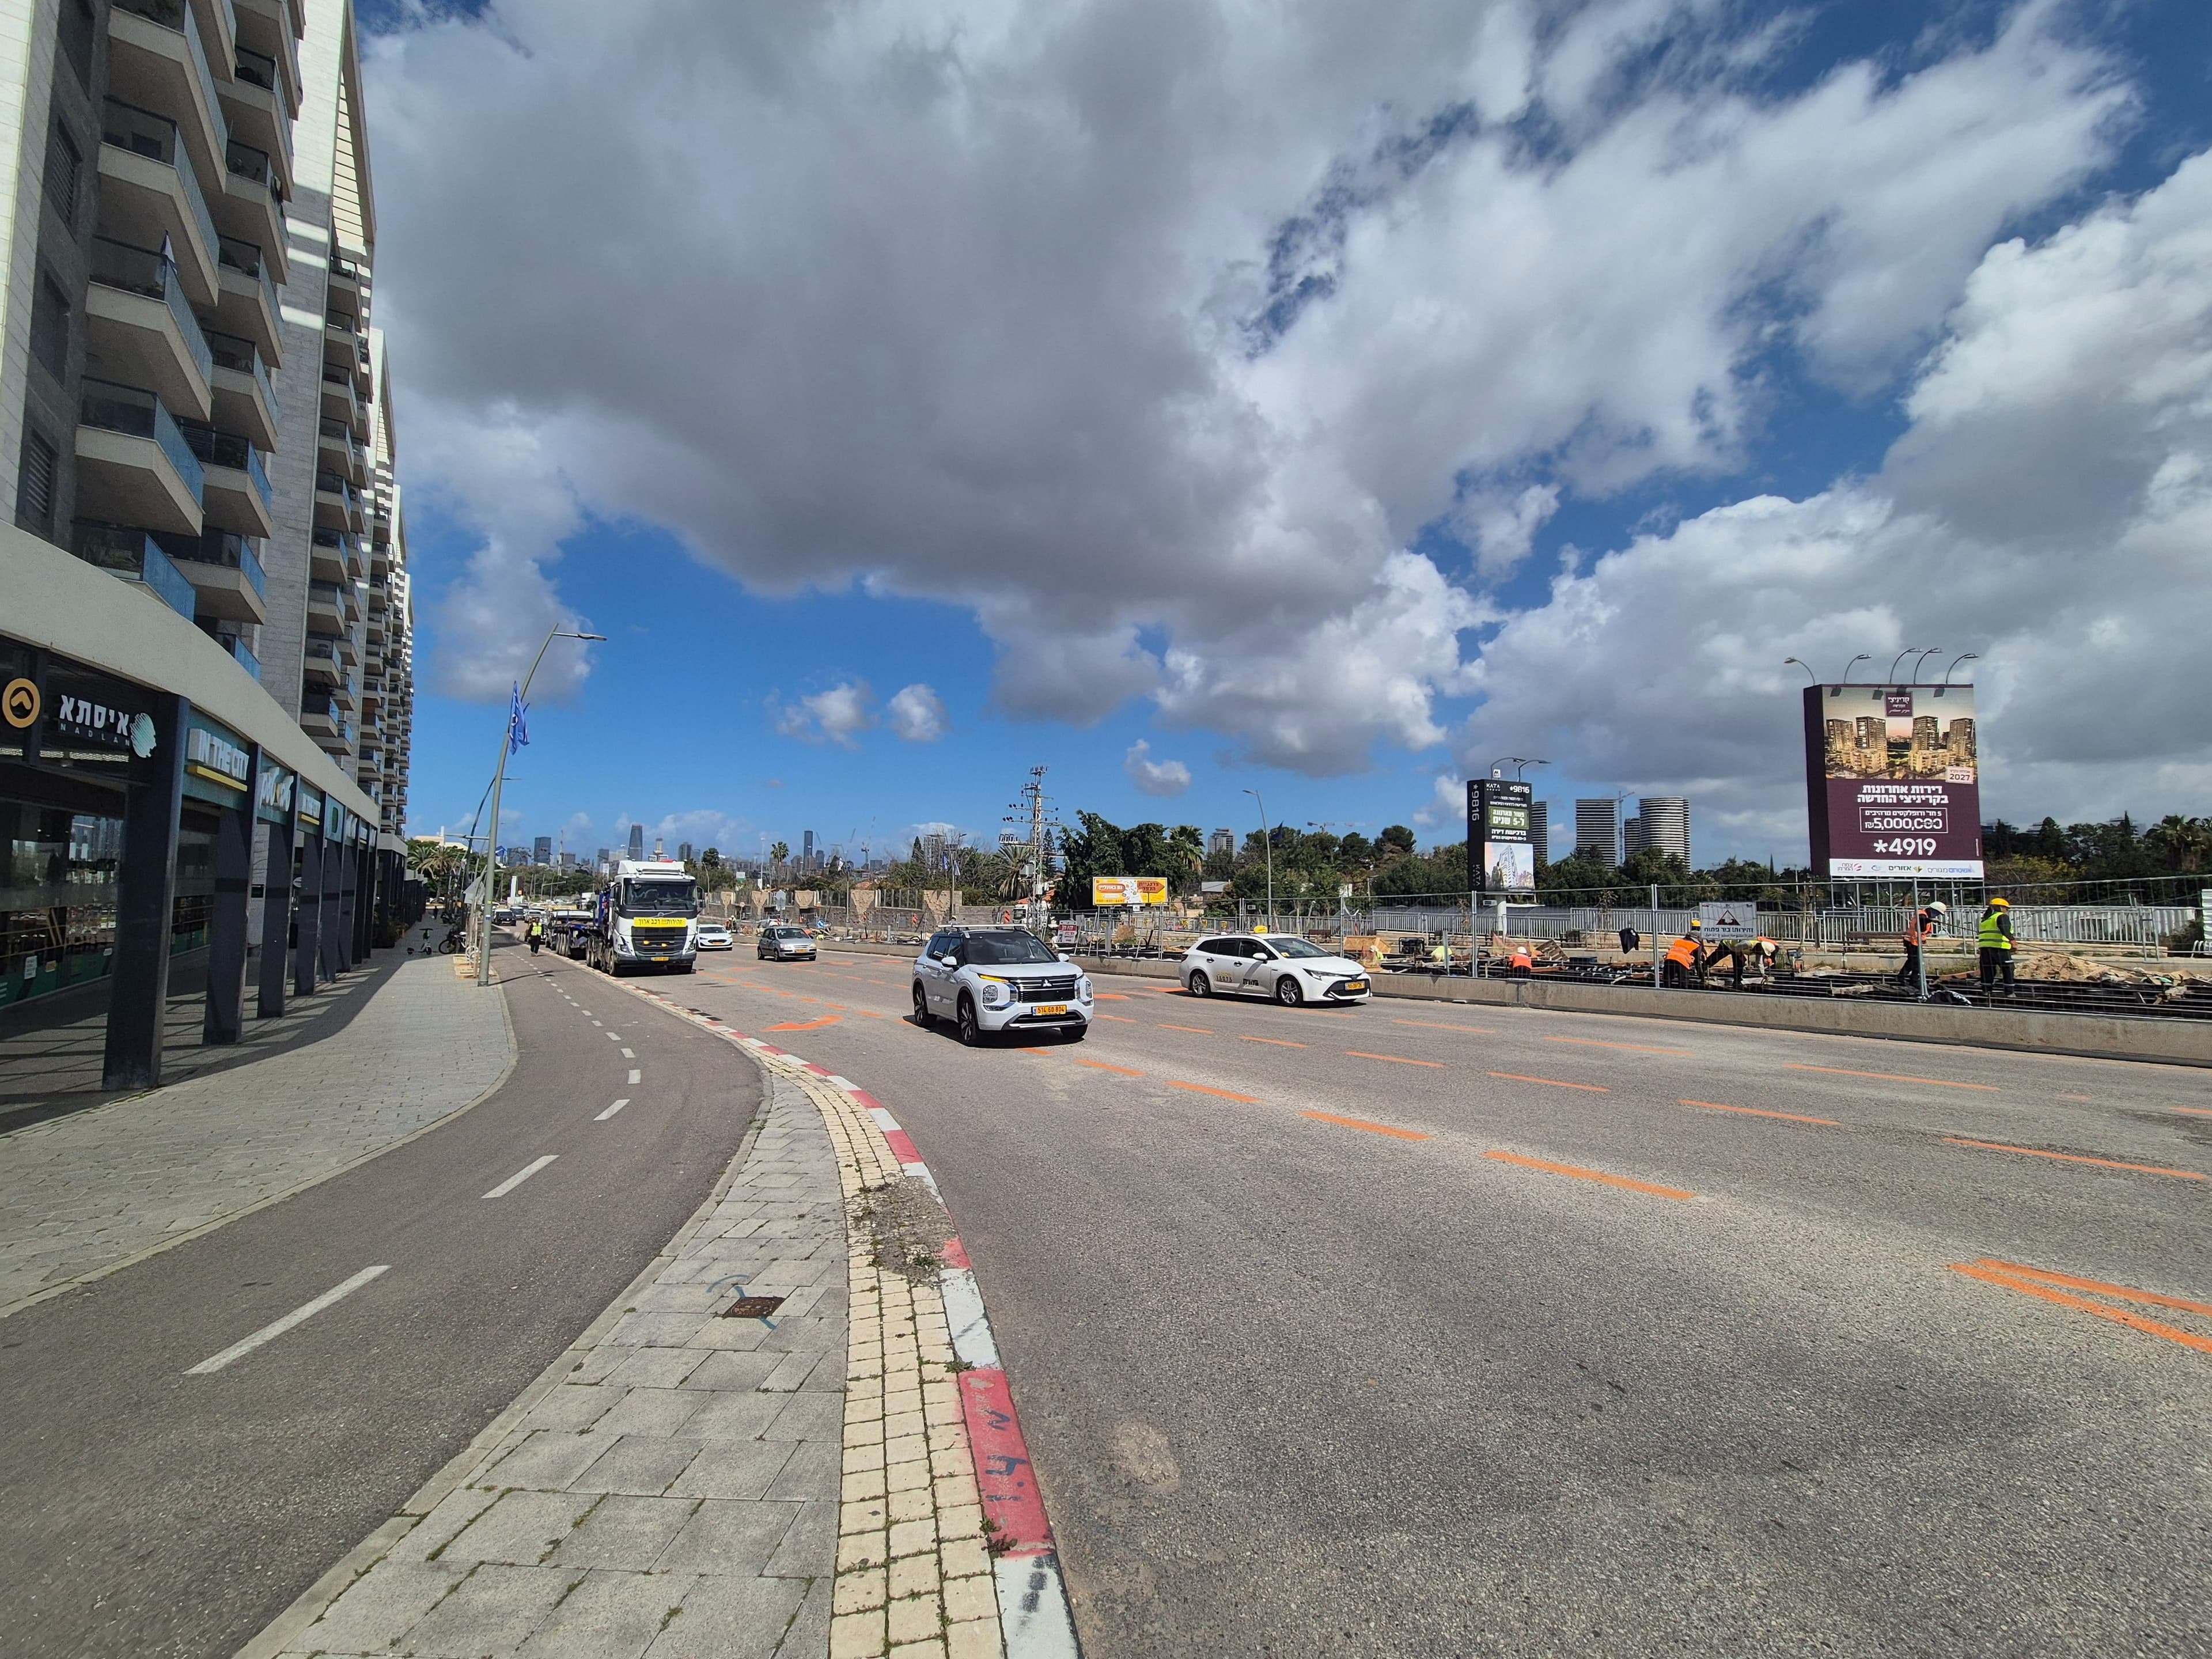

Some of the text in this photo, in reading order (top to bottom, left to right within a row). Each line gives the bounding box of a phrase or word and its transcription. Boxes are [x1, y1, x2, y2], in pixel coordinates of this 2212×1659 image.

[59, 694, 130, 736] איסתא
[60, 723, 130, 747] NADLAN
[211, 736, 232, 774] THE
[231, 748, 249, 781] CITY
[1857, 794, 1949, 806] בקריניצי החדשה
[1862, 785, 1942, 794] דירות אחרונות
